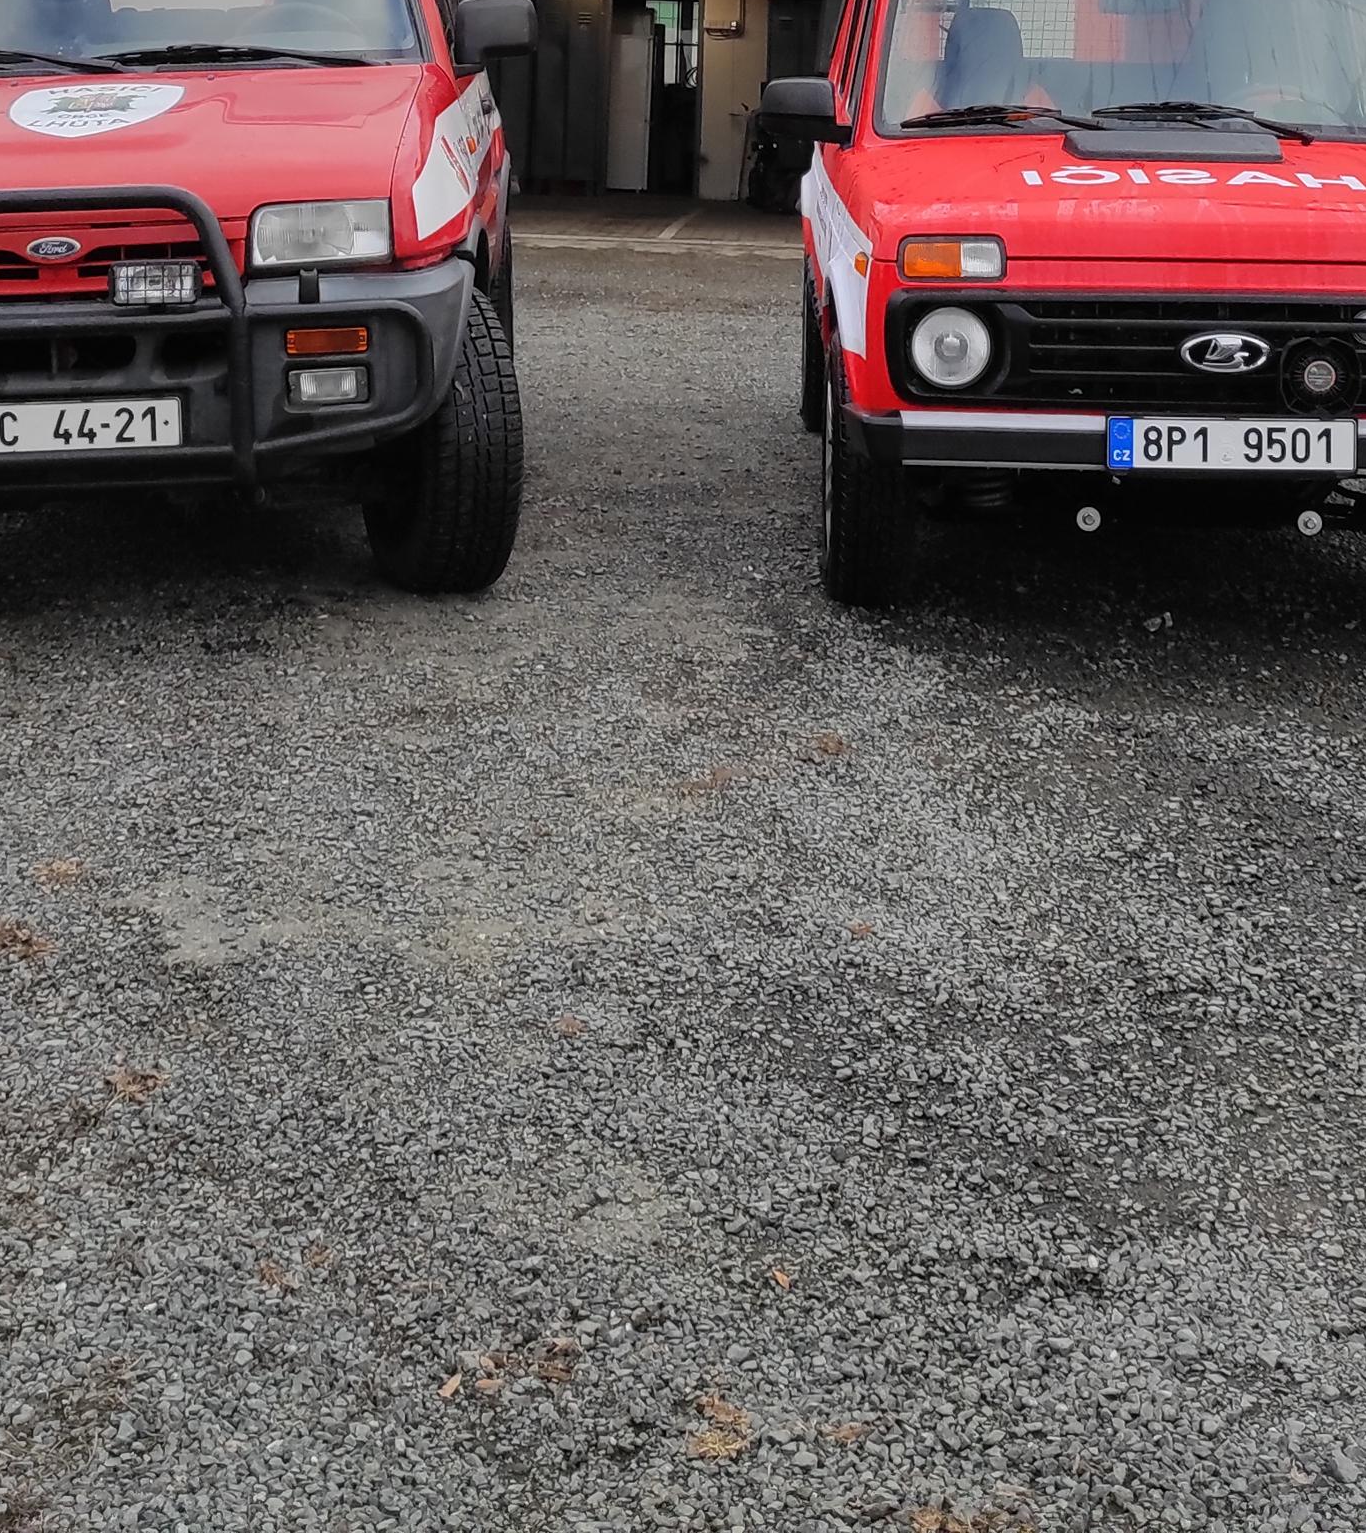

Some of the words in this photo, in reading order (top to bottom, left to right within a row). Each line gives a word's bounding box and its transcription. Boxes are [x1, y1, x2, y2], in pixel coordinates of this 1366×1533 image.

[38, 240, 68, 254] Ford
[53, 406, 157, 445] 44-21
[1113, 450, 1131, 462] CZ
[1143, 425, 1209, 463] 8P1
[1243, 427, 1332, 464] 9501
